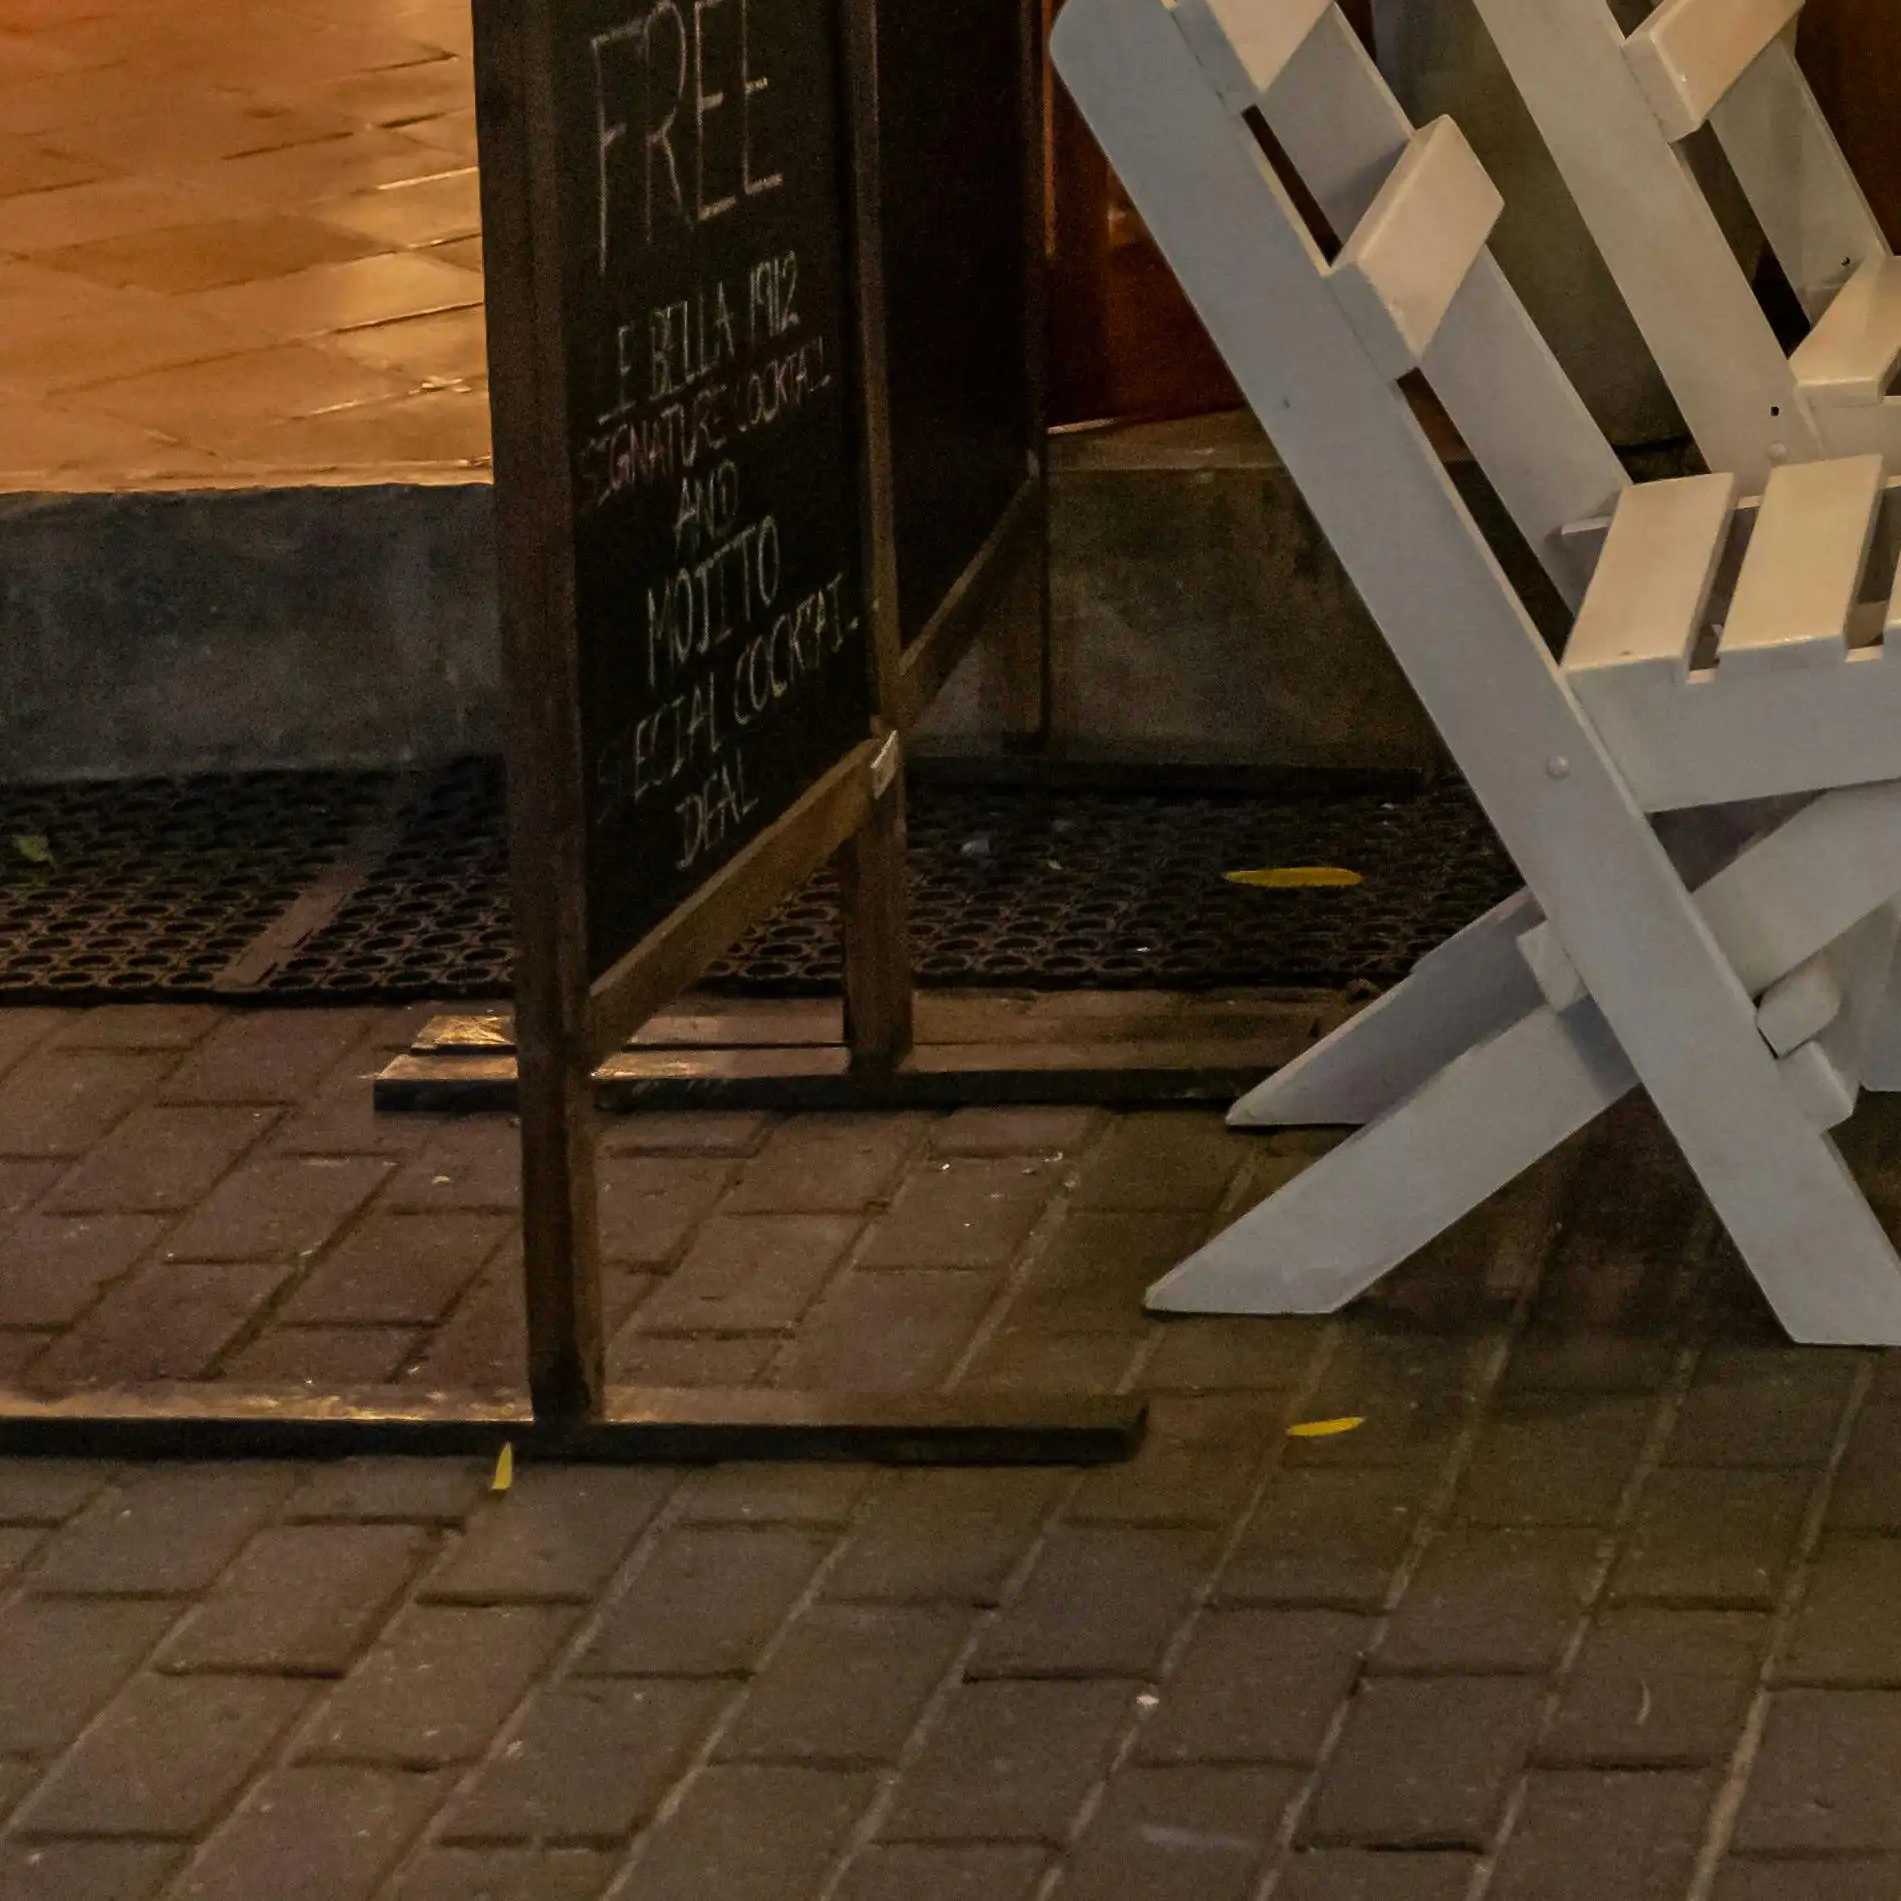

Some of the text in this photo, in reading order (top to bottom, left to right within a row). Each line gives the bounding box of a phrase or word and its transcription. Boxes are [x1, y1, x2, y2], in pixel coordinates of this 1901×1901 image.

[674, 457, 741, 556] AND
[645, 512, 783, 690] MOJITO
[596, 571, 860, 826] SECIAL COCKTAI
[673, 746, 761, 872] DEAL
